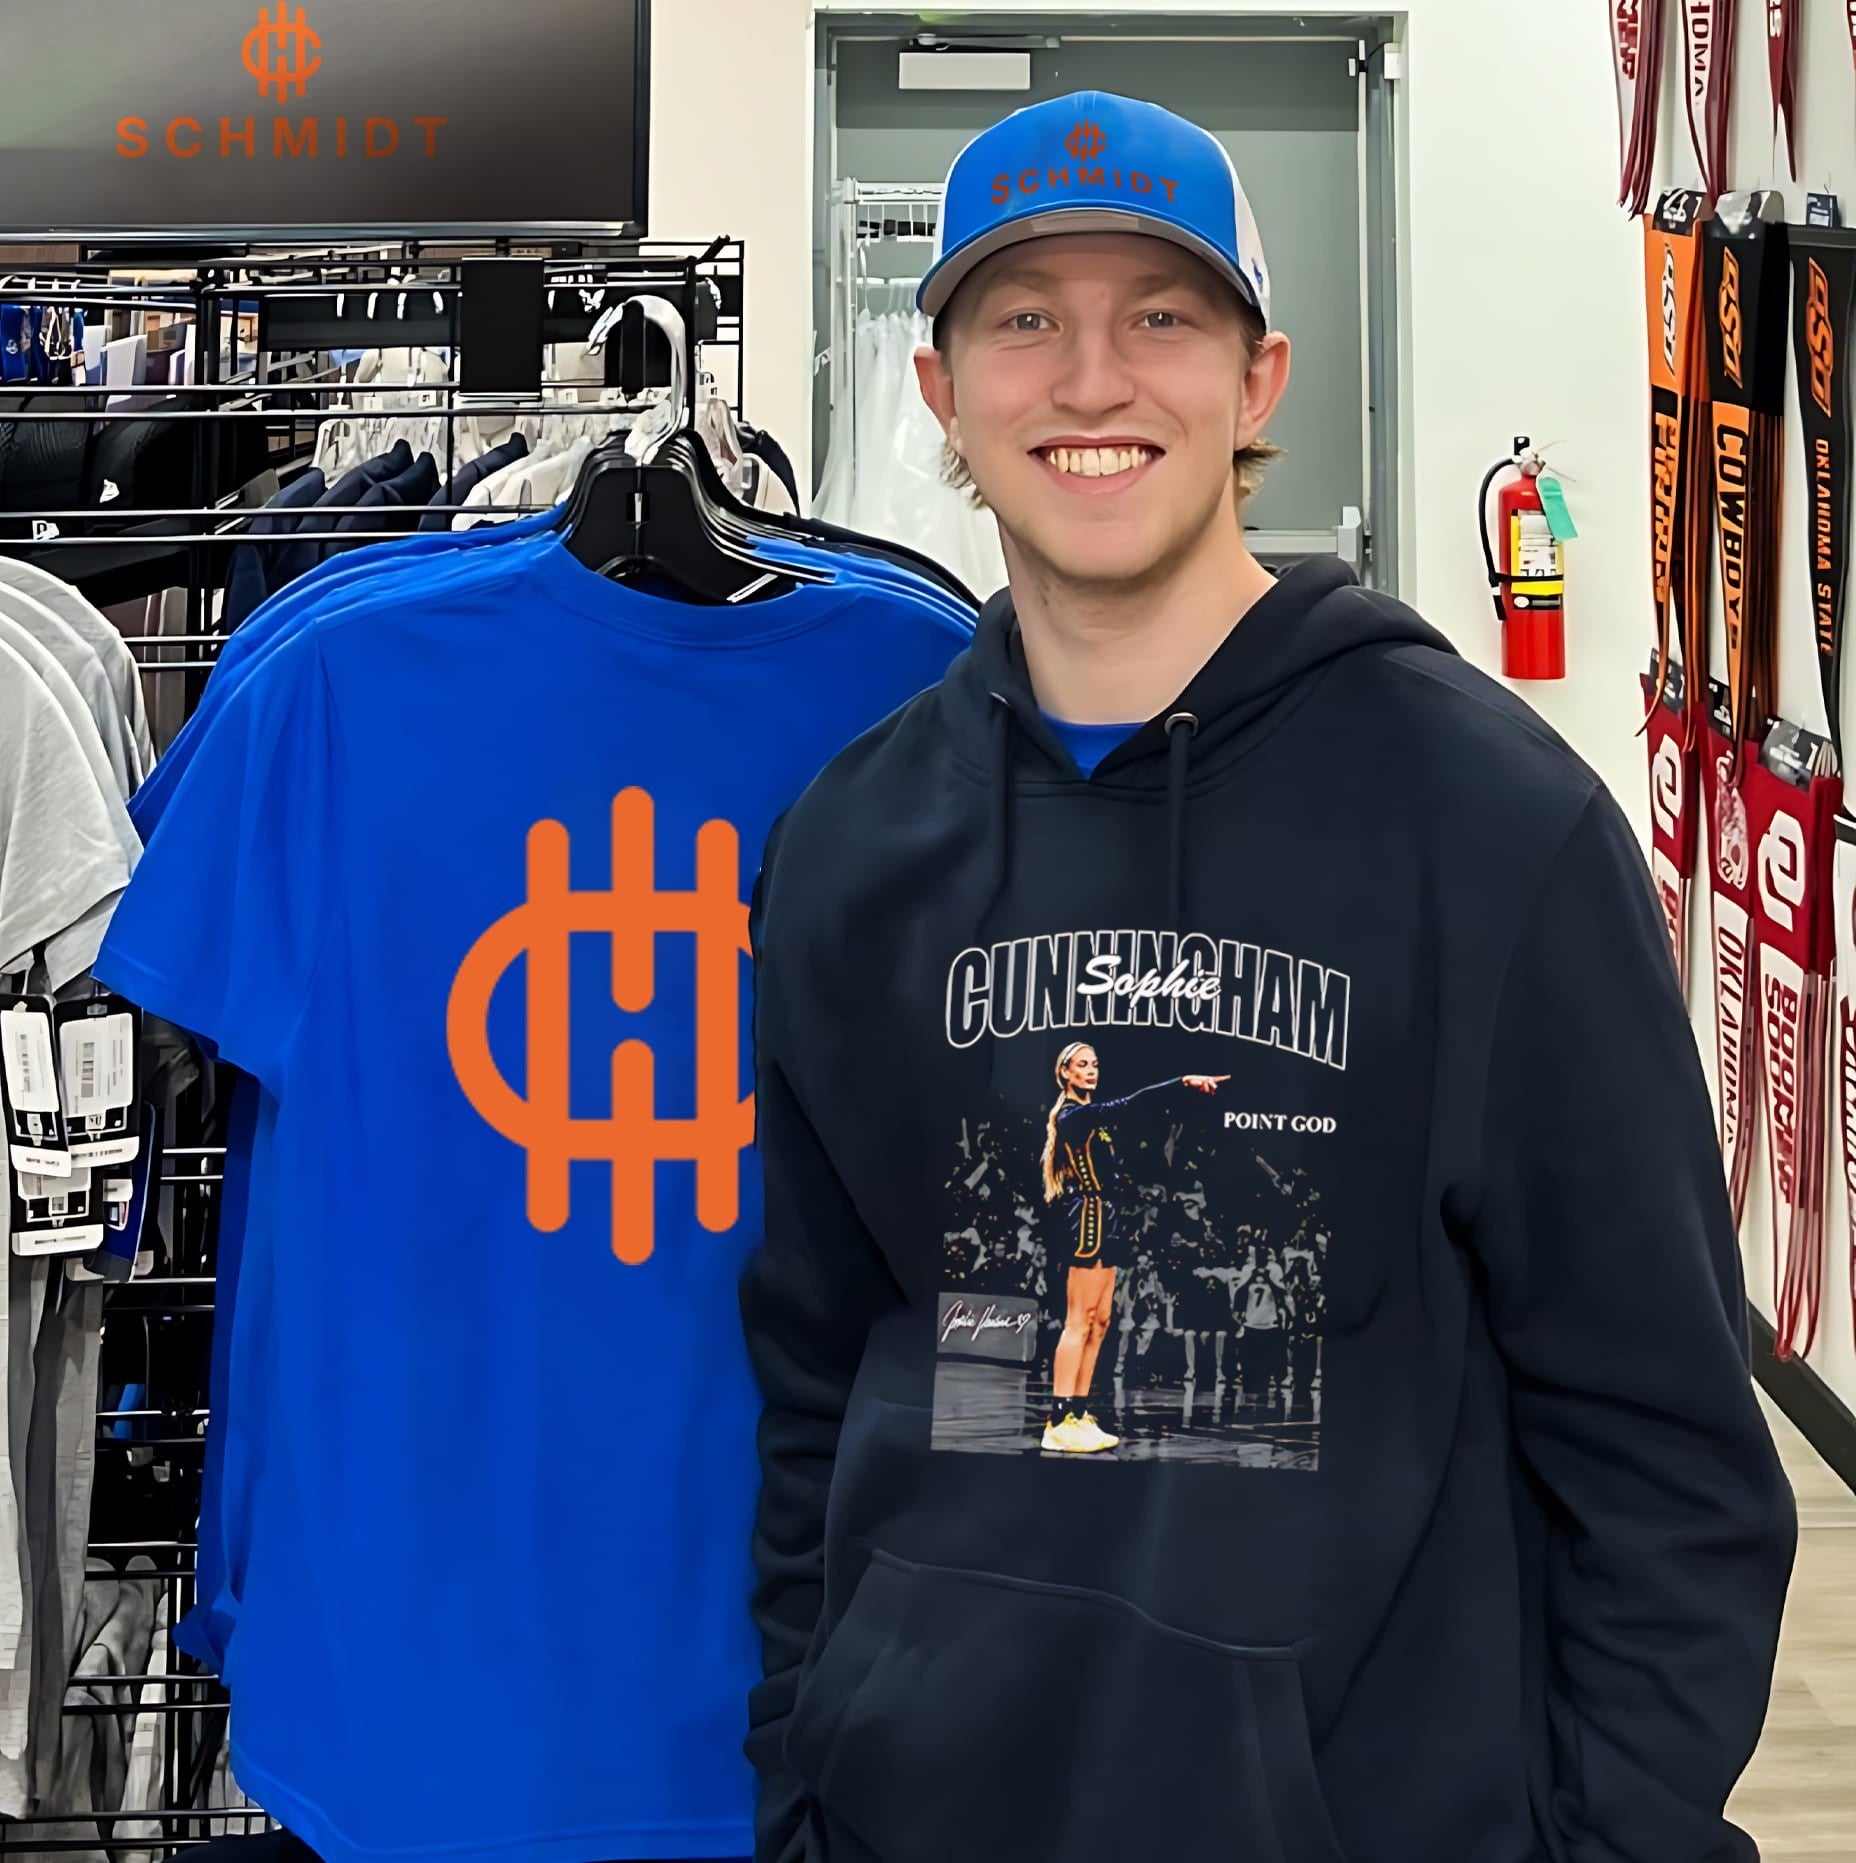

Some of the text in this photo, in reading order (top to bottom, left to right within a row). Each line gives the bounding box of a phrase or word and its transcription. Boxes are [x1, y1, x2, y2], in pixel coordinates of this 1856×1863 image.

[116, 117, 447, 158] SCHMIDT
[991, 168, 1179, 204] SCHMIDT
[1815, 438, 1832, 570] OKLAHOMA
[946, 930, 1350, 1071] CUNNINGHAM
[1077, 954, 1222, 1008] Sophie
[1223, 1111, 1337, 1133] POINT GOD
